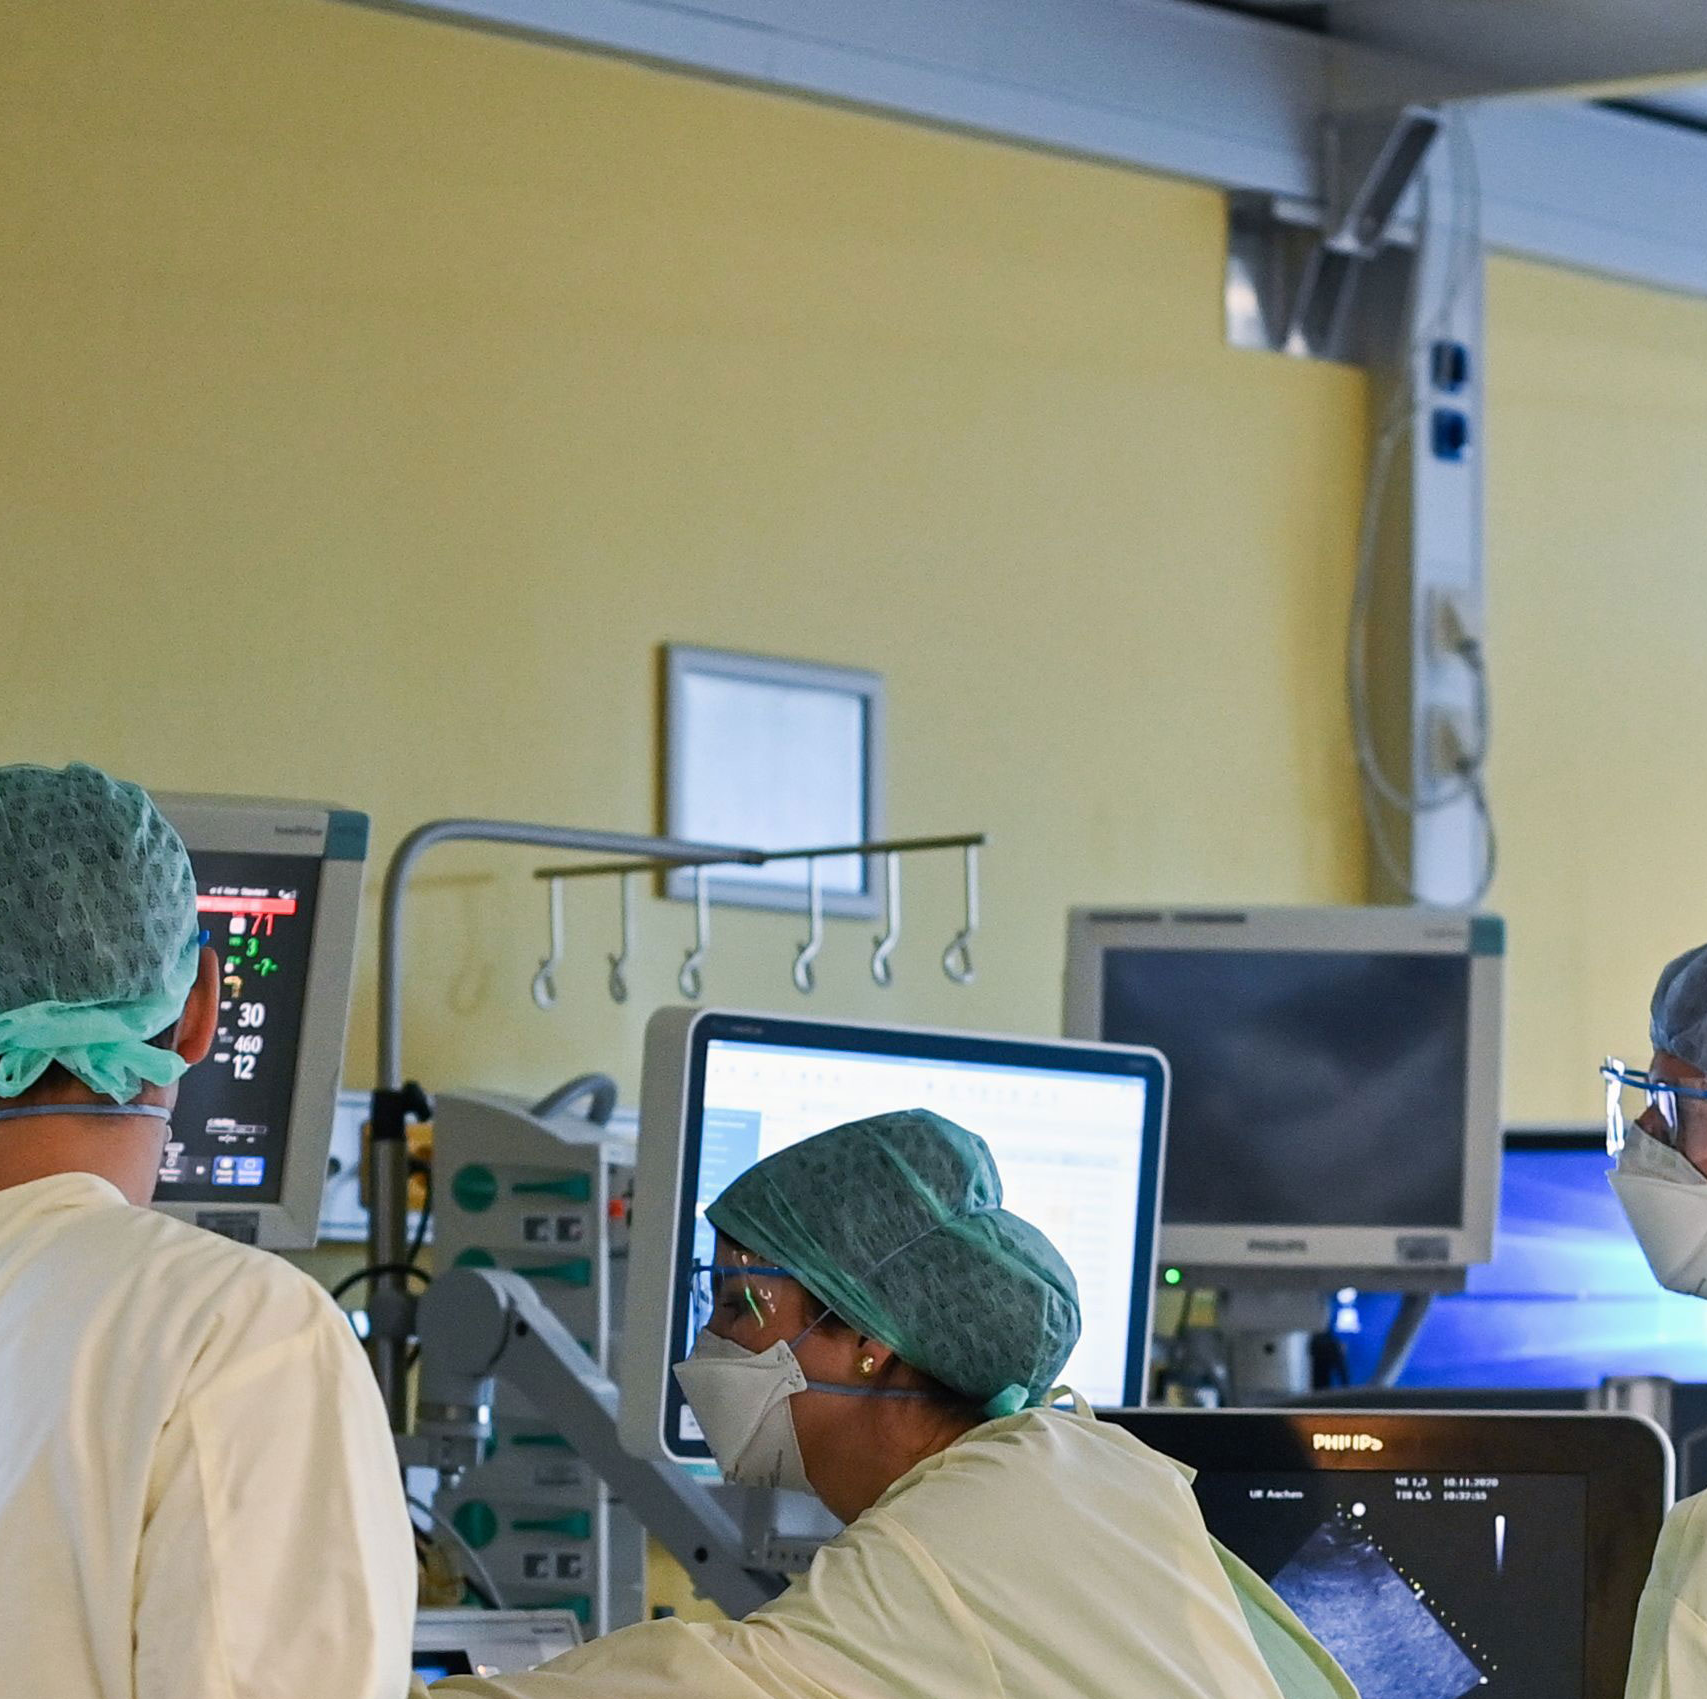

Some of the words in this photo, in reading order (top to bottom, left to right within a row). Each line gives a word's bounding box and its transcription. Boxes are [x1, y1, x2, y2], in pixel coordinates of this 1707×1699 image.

[251, 913, 274, 936] 71
[237, 1002, 265, 1028] 30
[234, 1034, 264, 1054] 460
[232, 1054, 257, 1079] 12
